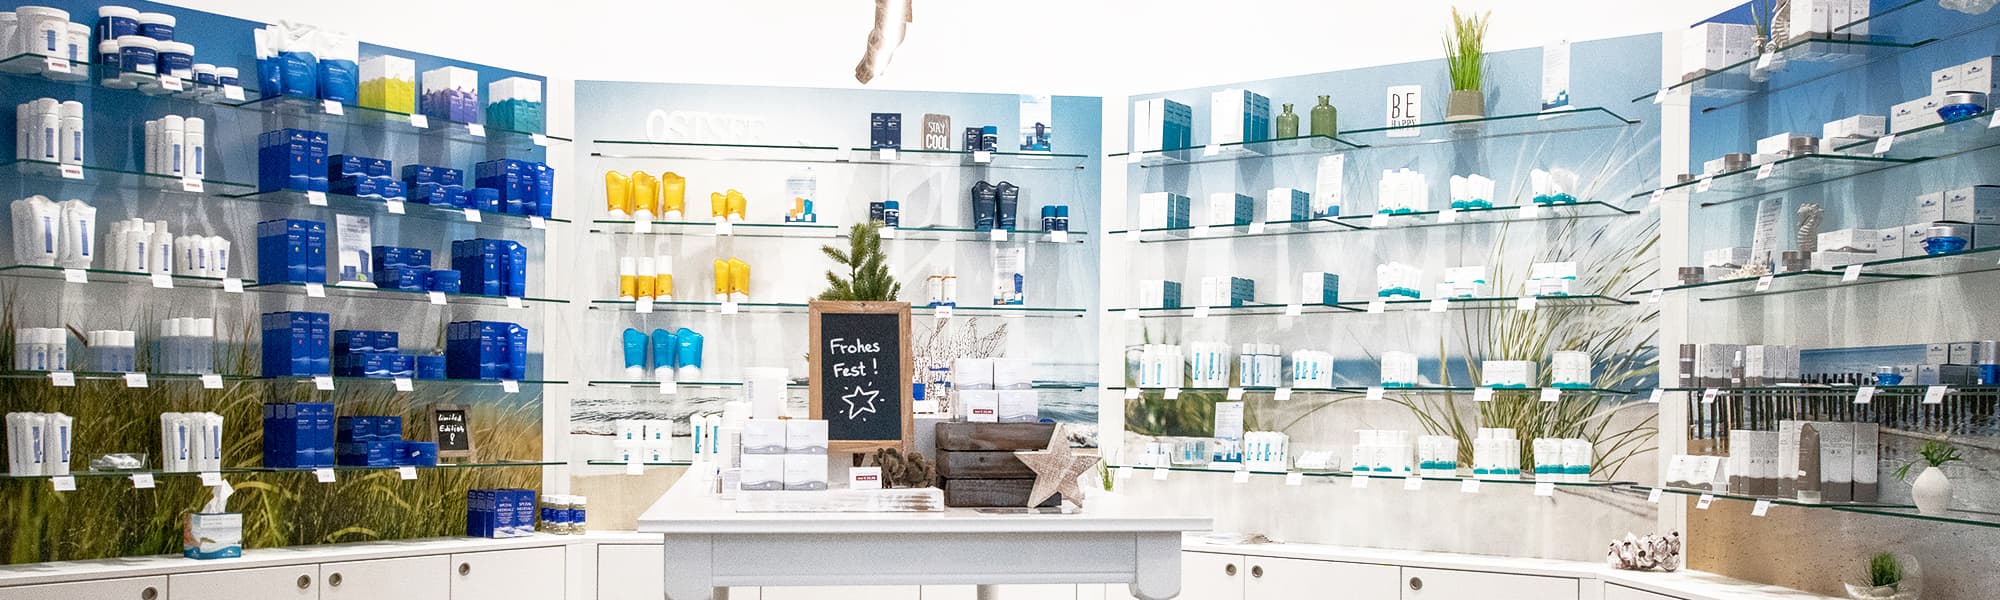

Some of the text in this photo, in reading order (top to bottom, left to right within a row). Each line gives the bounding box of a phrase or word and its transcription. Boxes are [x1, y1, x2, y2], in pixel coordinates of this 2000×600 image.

[1392, 93, 1415, 118] BE
[928, 121, 945, 134] STAY
[926, 133, 949, 150] COOL
[830, 338, 880, 355] Frohes
[833, 361, 867, 378] Fest
